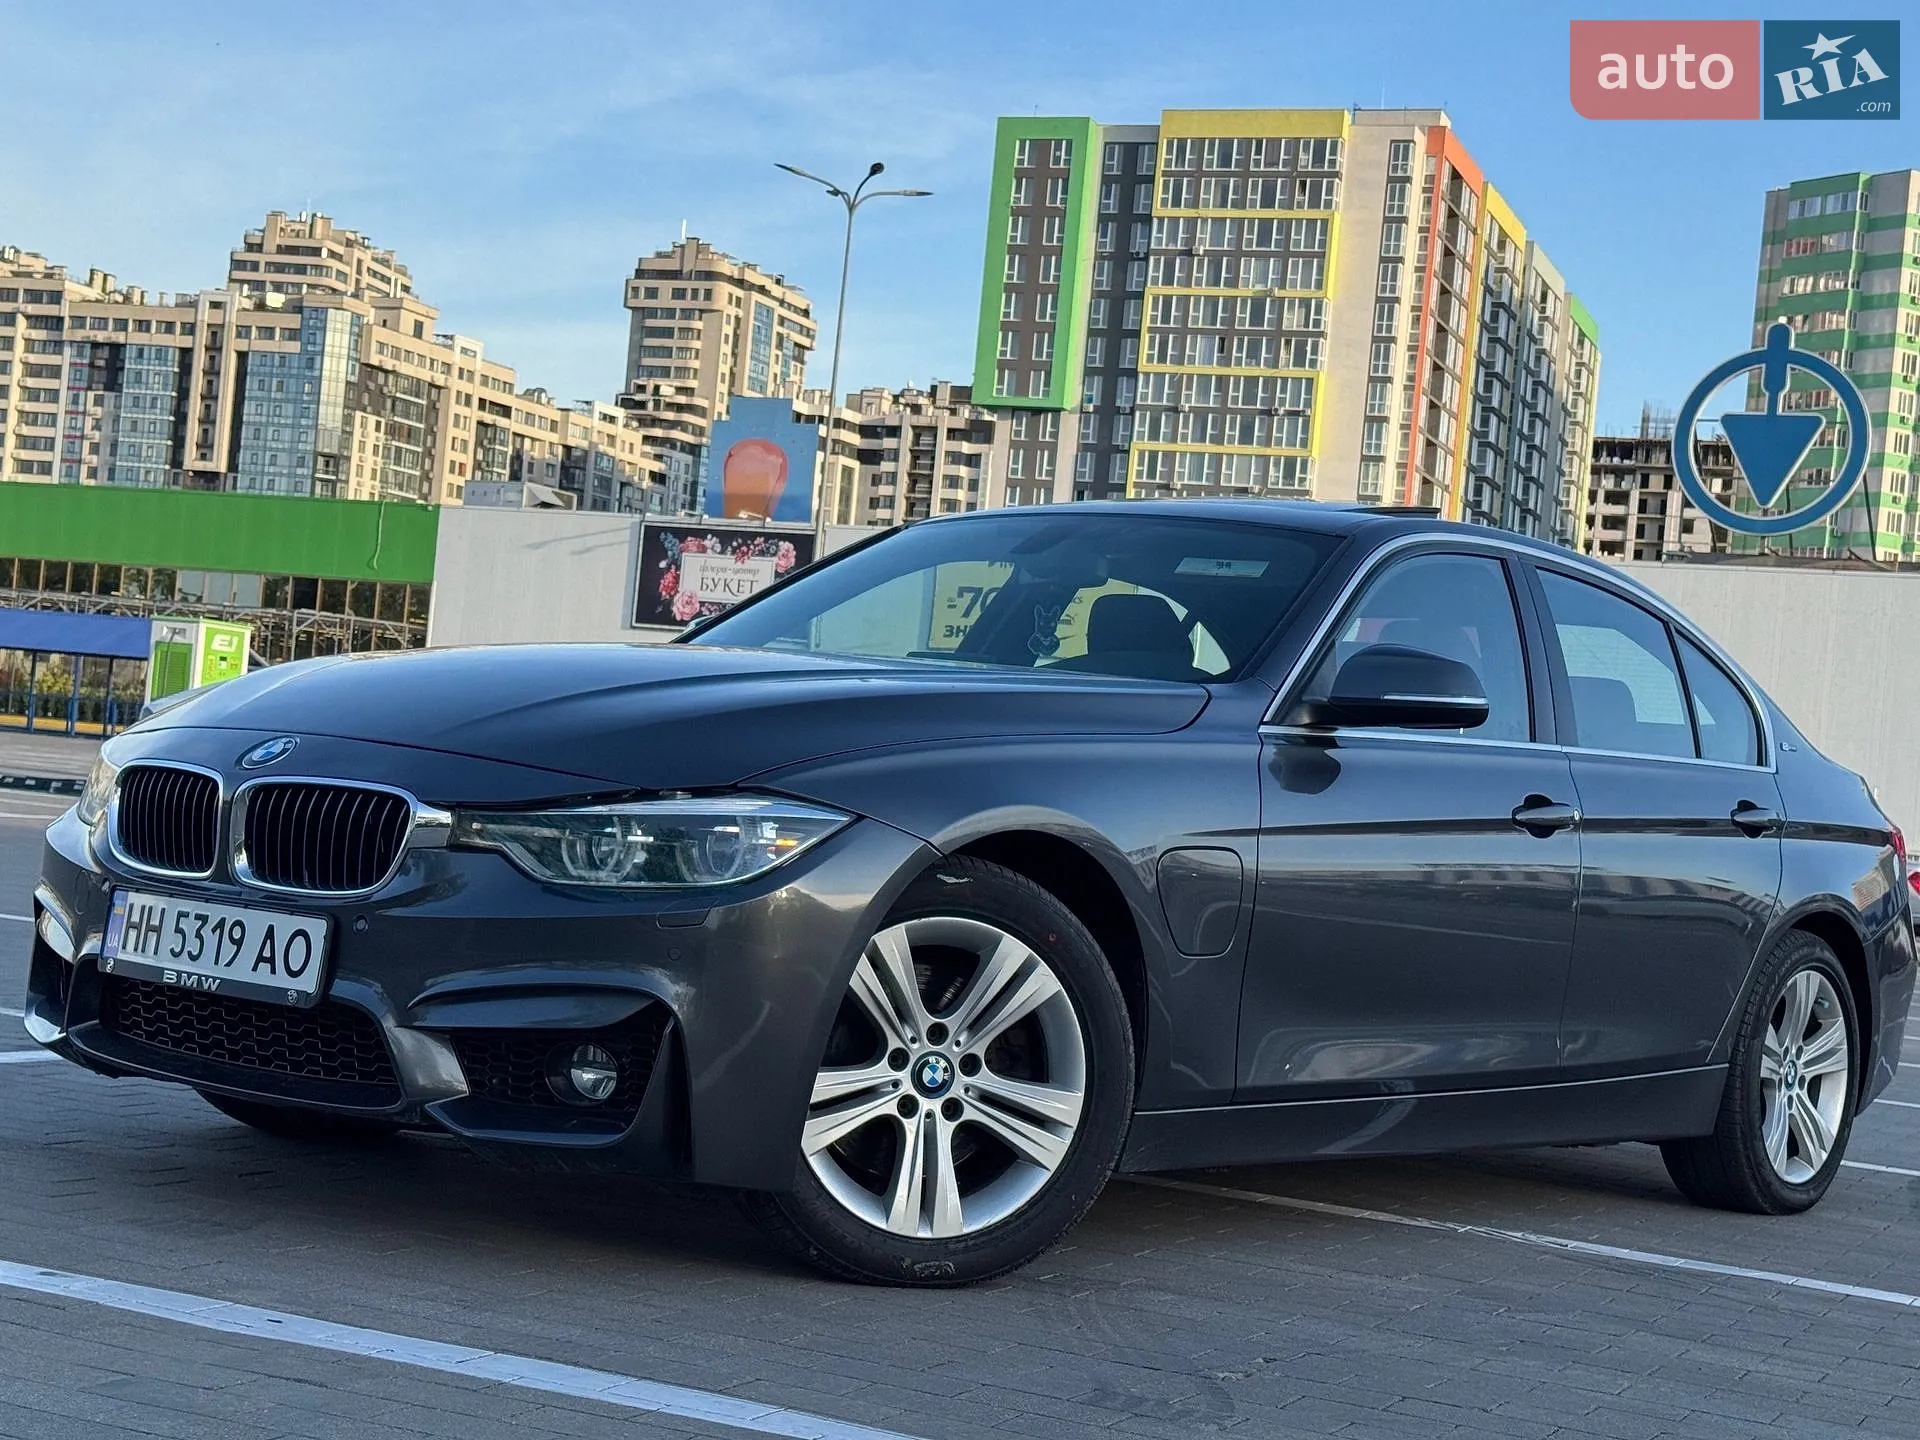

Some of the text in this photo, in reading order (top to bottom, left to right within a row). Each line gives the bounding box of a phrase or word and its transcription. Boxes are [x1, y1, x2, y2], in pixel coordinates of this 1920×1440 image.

[700, 577, 760, 597] БУКЕТ
[107, 932, 118, 948] UA
[122, 902, 312, 978] HH 5319 AO
[163, 970, 221, 992] BMW
